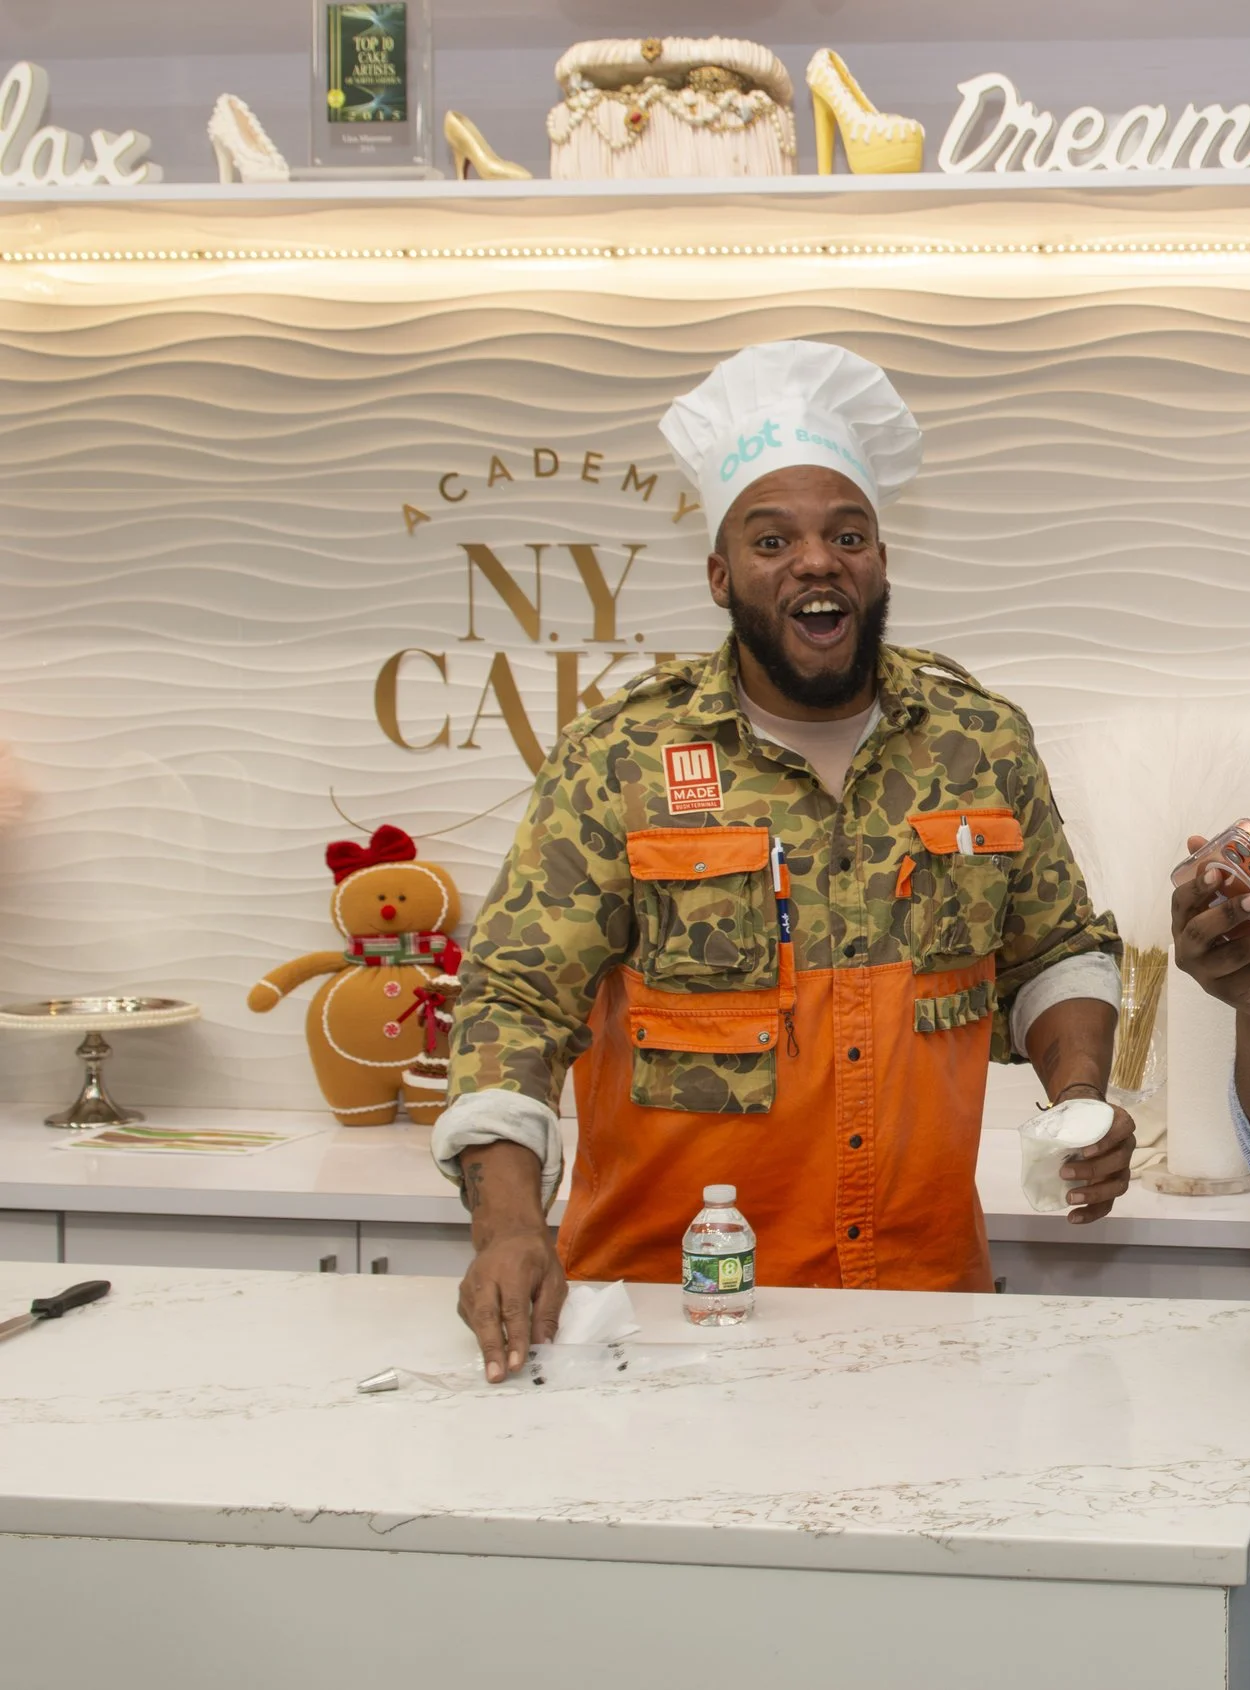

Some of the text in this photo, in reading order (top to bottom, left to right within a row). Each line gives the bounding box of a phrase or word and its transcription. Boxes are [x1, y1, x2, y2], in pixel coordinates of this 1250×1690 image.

[353, 36, 394, 51] TOP 10
[357, 51, 388, 63] CAKE
[352, 63, 396, 75] ARTISTS
[719, 418, 783, 483] obt
[402, 447, 700, 537] ACADEMY
[456, 542, 647, 644] N.Y.
[674, 786, 716, 800] MADE
